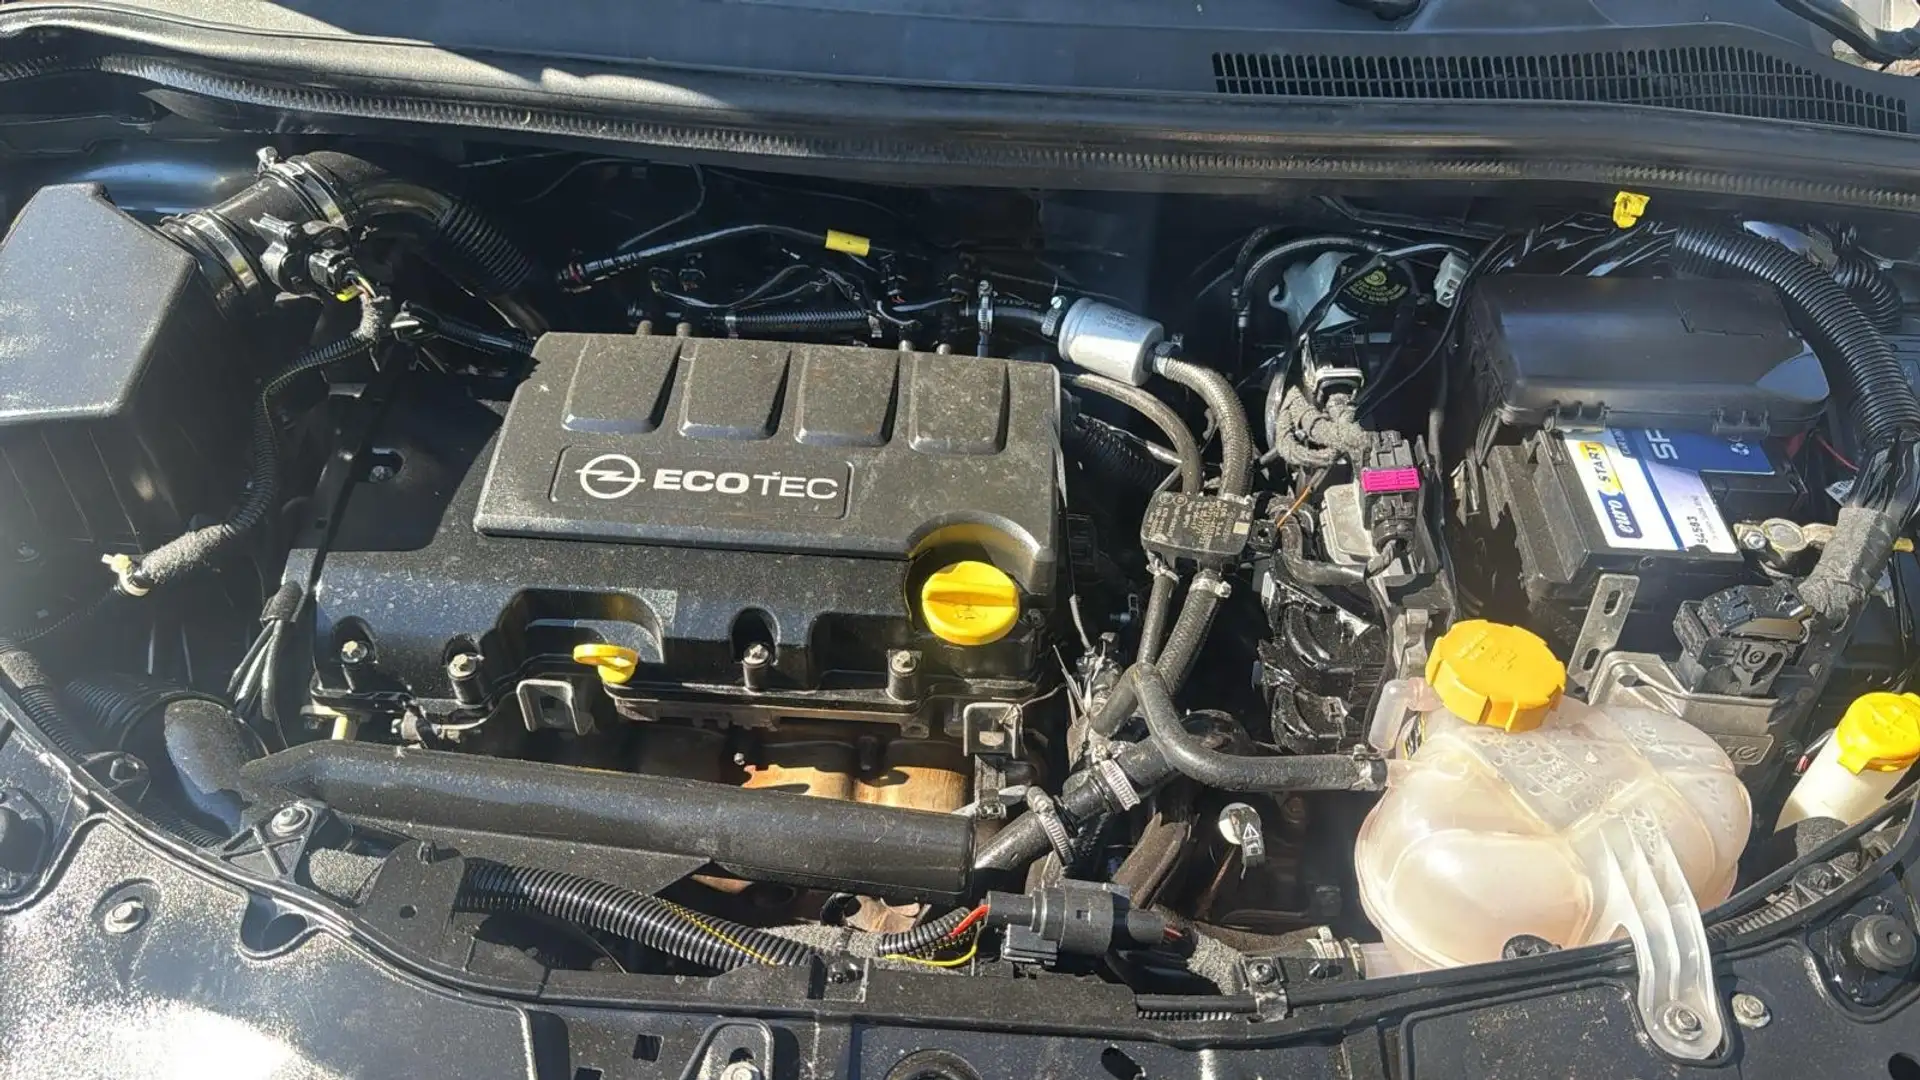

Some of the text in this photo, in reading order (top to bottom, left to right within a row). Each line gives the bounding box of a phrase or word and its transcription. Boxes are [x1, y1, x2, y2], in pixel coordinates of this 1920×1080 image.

[653, 468, 838, 500] ECOTEC
[1586, 444, 1634, 535] euro START
